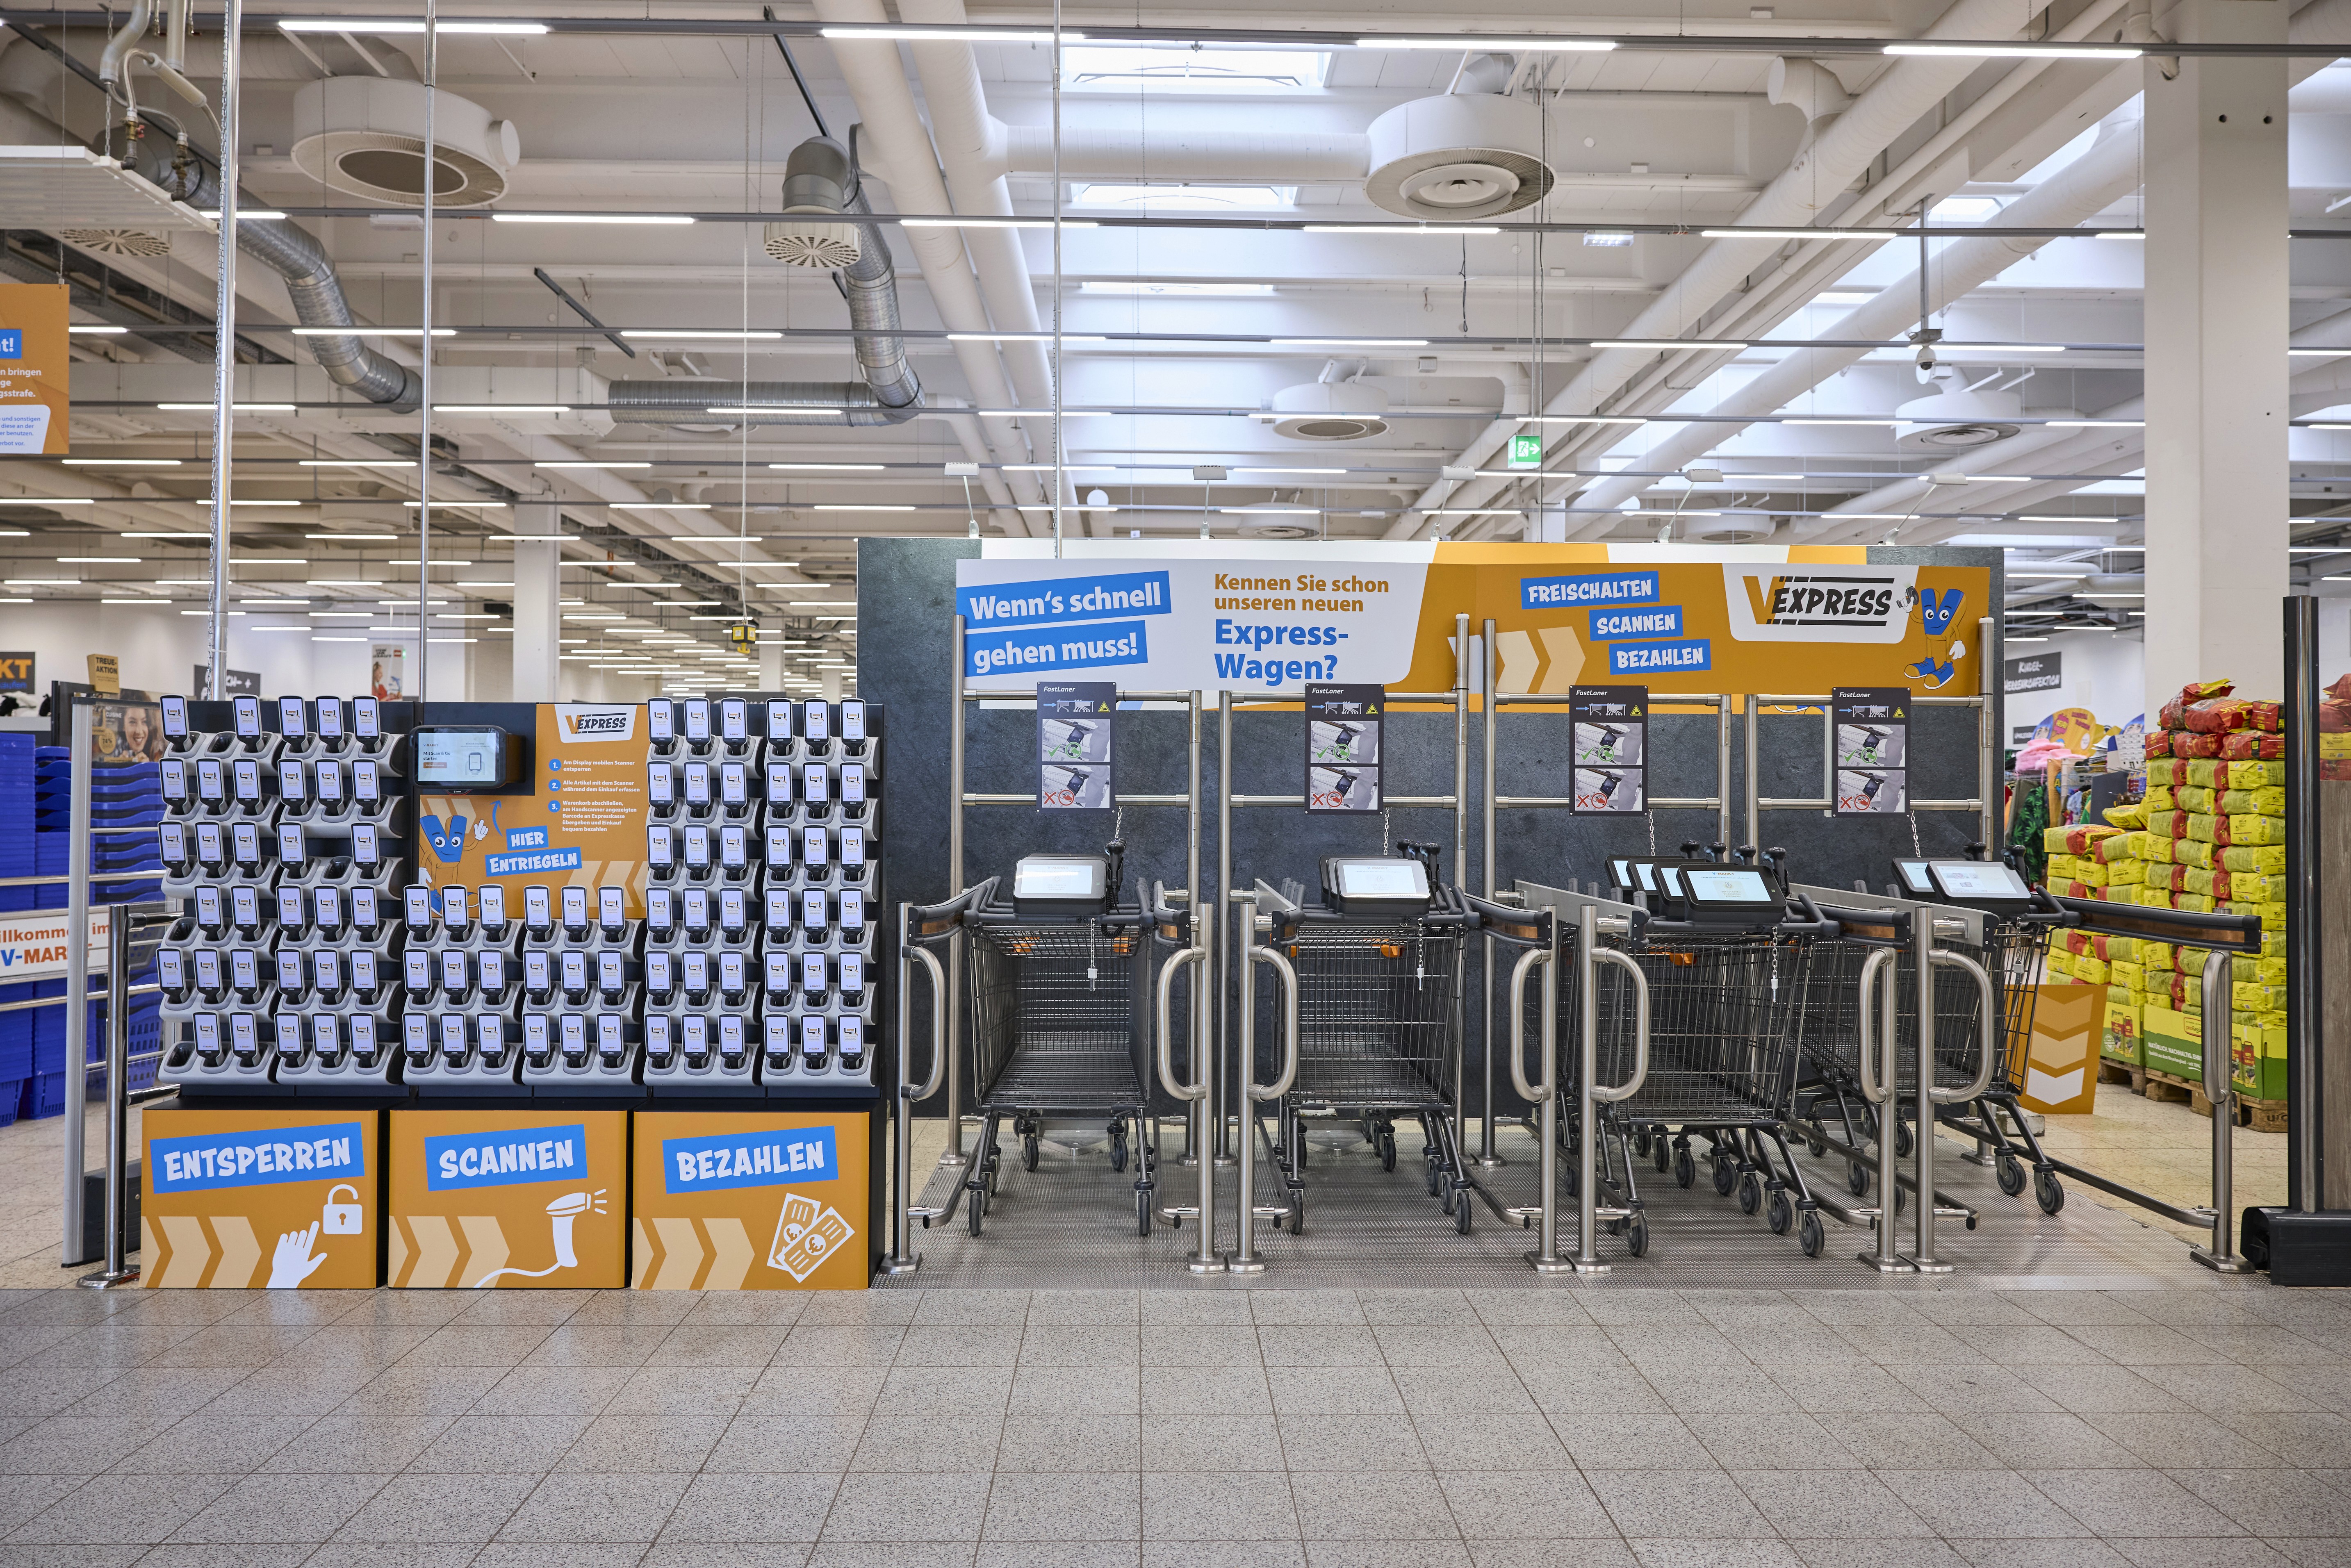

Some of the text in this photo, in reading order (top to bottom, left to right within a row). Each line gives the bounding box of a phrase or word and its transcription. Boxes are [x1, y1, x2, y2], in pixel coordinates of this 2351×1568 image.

[8, 368, 41, 378] bringen
[1216, 574, 1388, 592] Kennen Sie schon
[1529, 580, 1651, 602] FREISCHALTEN
[1070, 582, 1160, 612] schnell
[1216, 599, 1362, 611] unseren neuen
[1597, 614, 1675, 634] SCANNEN
[1216, 619, 1348, 651] Express-
[96, 657, 116, 665] TREUE-
[975, 633, 1137, 674] gehen muss!
[1617, 648, 1703, 668] BEZAHLEN
[96, 666, 117, 674] AKTION
[1214, 653, 1337, 686] Wagen?
[511, 832, 544, 847] HIER
[490, 853, 577, 873] ENTRIEGELN
[164, 1138, 350, 1181] ENTSPERREN
[440, 1140, 573, 1178] SCANNEN
[677, 1141, 824, 1181] BEZAHLEN
